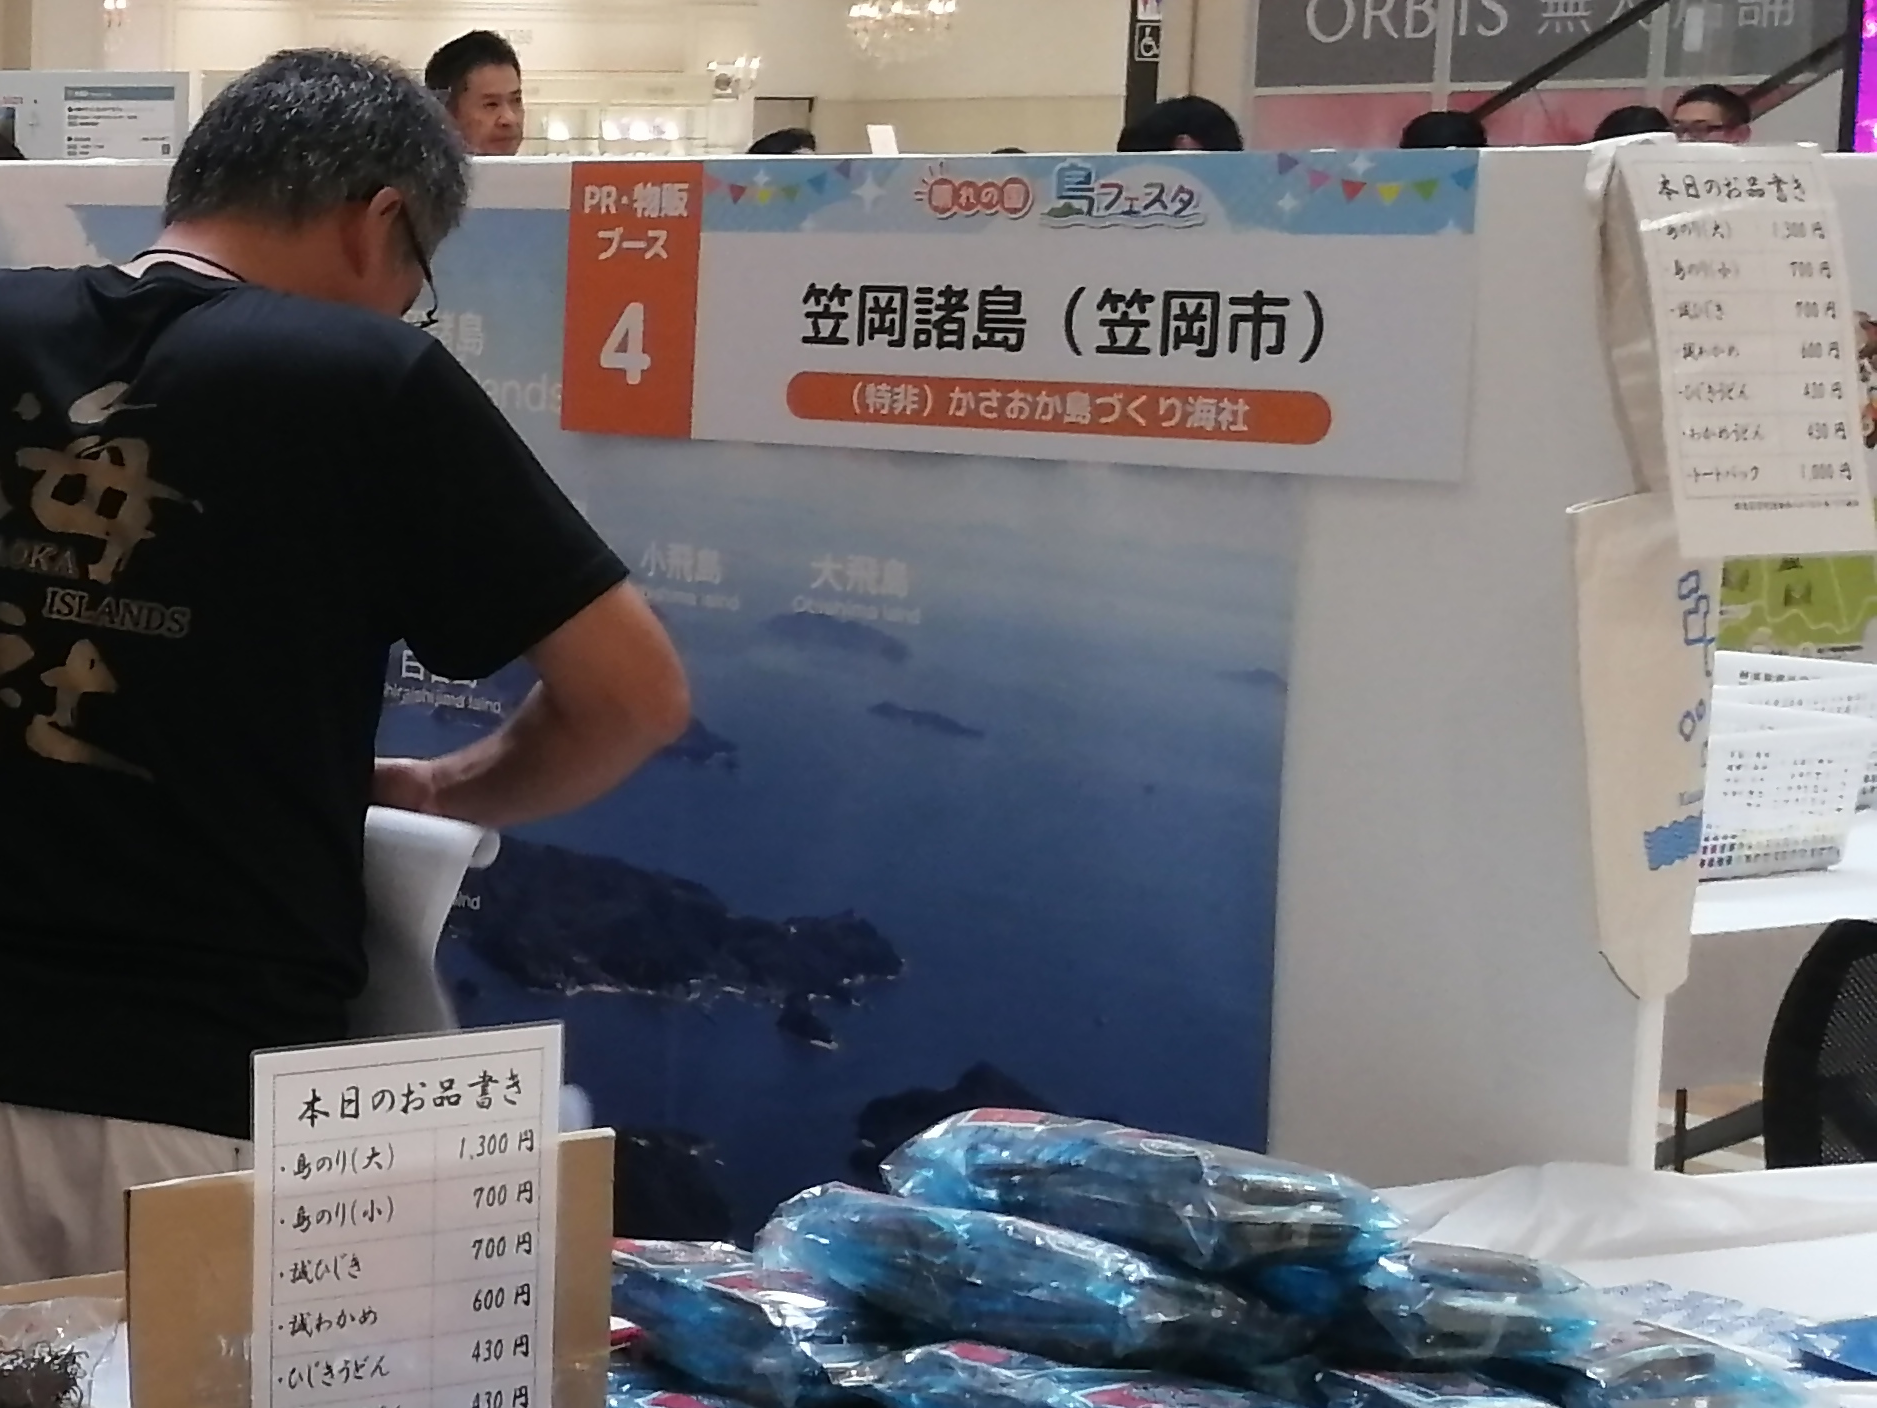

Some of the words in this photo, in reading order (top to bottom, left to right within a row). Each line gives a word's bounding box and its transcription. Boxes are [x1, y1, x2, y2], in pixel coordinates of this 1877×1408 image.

[583, 183, 687, 217] PR・物販
[1054, 165, 1198, 217] 島フェスタ
[1658, 173, 1806, 203] 本日のお品書き
[598, 230, 669, 260] ブース
[801, 283, 1325, 362] 笠岡諸島（笠岡市）
[600, 302, 651, 385] 4
[851, 381, 1249, 431] （特非）かさおか島づくり海社
[44, 587, 191, 638] ISLANDS
[298, 1068, 523, 1127] 本日のお品書き
[473, 1180, 533, 1211] 700円
[471, 1232, 532, 1261] 700円
[472, 1283, 531, 1312] 600円
[471, 1334, 530, 1363] 430円
